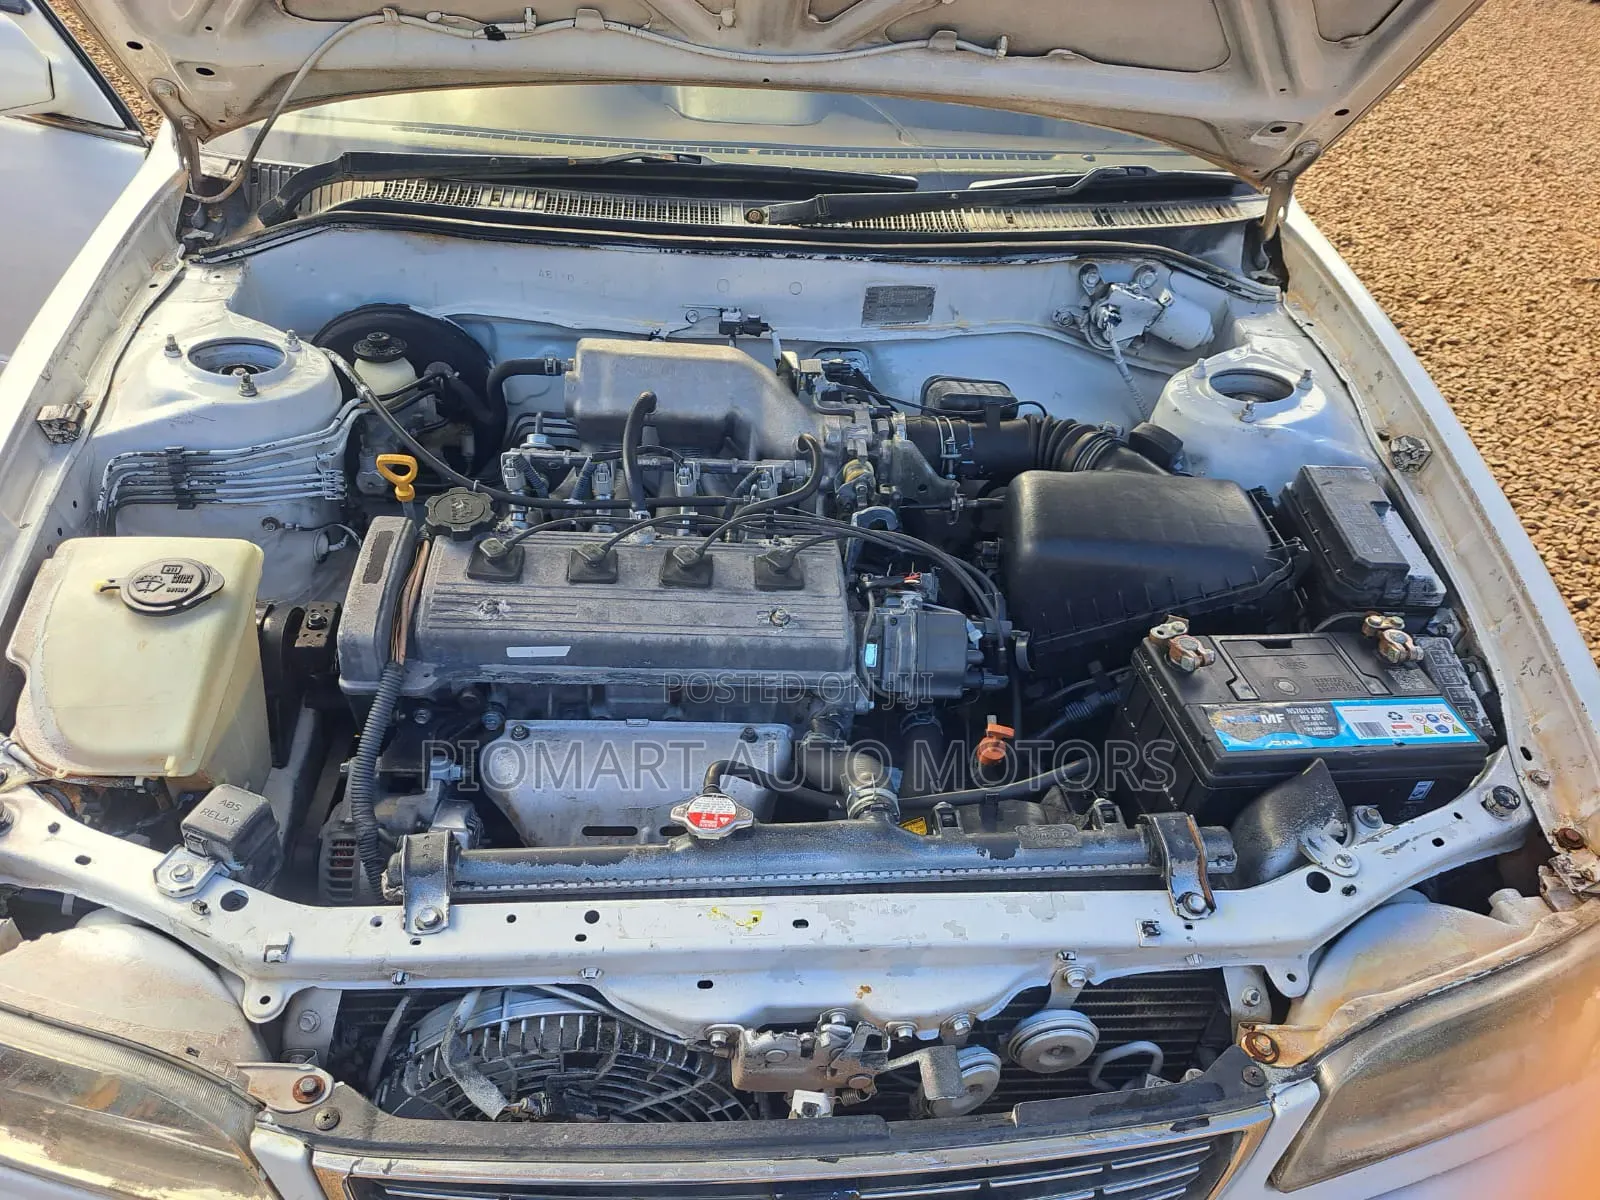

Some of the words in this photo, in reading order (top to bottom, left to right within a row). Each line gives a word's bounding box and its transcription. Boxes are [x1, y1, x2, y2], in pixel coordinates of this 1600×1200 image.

[1260, 713, 1285, 725] MF
[218, 799, 242, 812] ABS
[200, 807, 240, 826] RELAY
